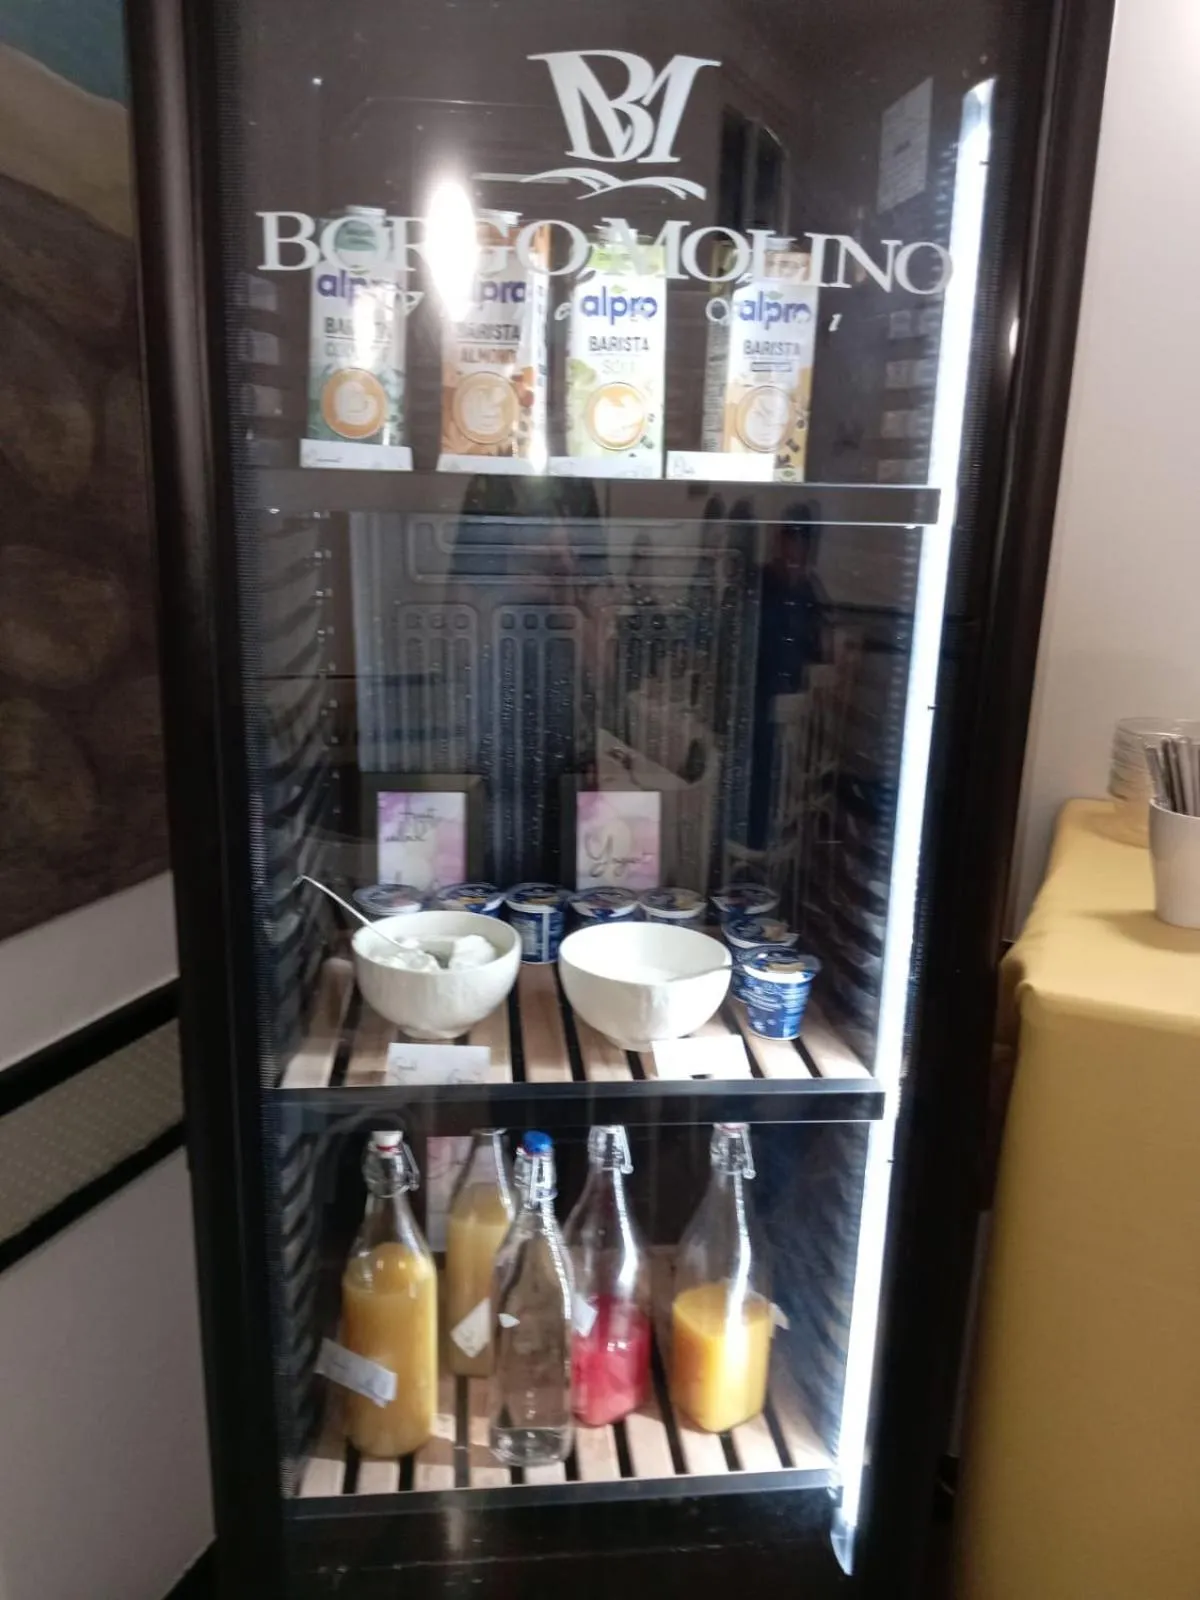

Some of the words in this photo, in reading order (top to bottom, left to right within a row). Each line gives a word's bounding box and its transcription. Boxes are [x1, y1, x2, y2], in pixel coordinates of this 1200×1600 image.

[594, 217, 953, 296] MOLINO
[580, 285, 659, 326] alpro
[738, 290, 814, 331] alpro
[588, 335, 651, 353] BARISTA
[742, 338, 802, 357] BARISTA
